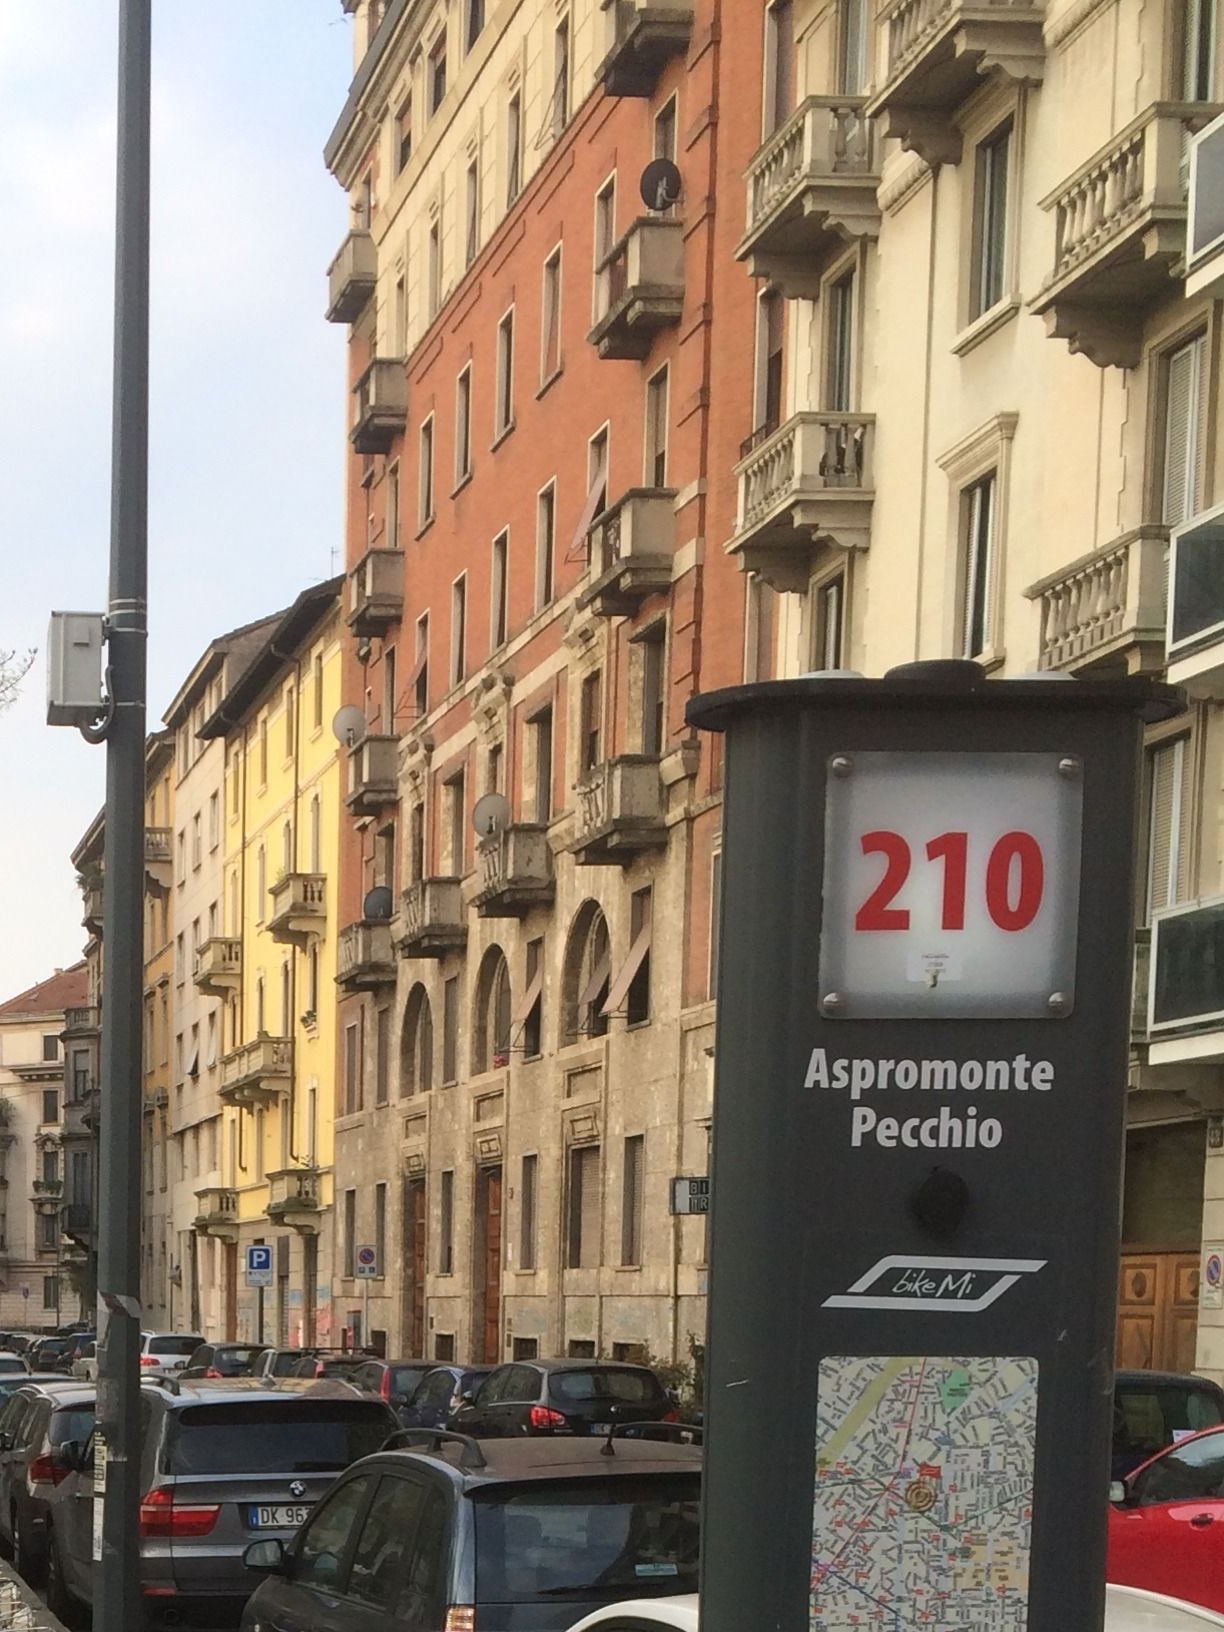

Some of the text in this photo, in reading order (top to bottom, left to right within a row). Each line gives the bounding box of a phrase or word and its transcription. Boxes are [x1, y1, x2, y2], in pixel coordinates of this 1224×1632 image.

[855, 830, 1045, 932] 210
[804, 1048, 1055, 1099] Aspromonte
[850, 1106, 1003, 1148] Pecchio
[252, 1251, 266, 1267] P
[892, 1269, 976, 1298] bikeMi
[261, 1508, 279, 1524] DK
